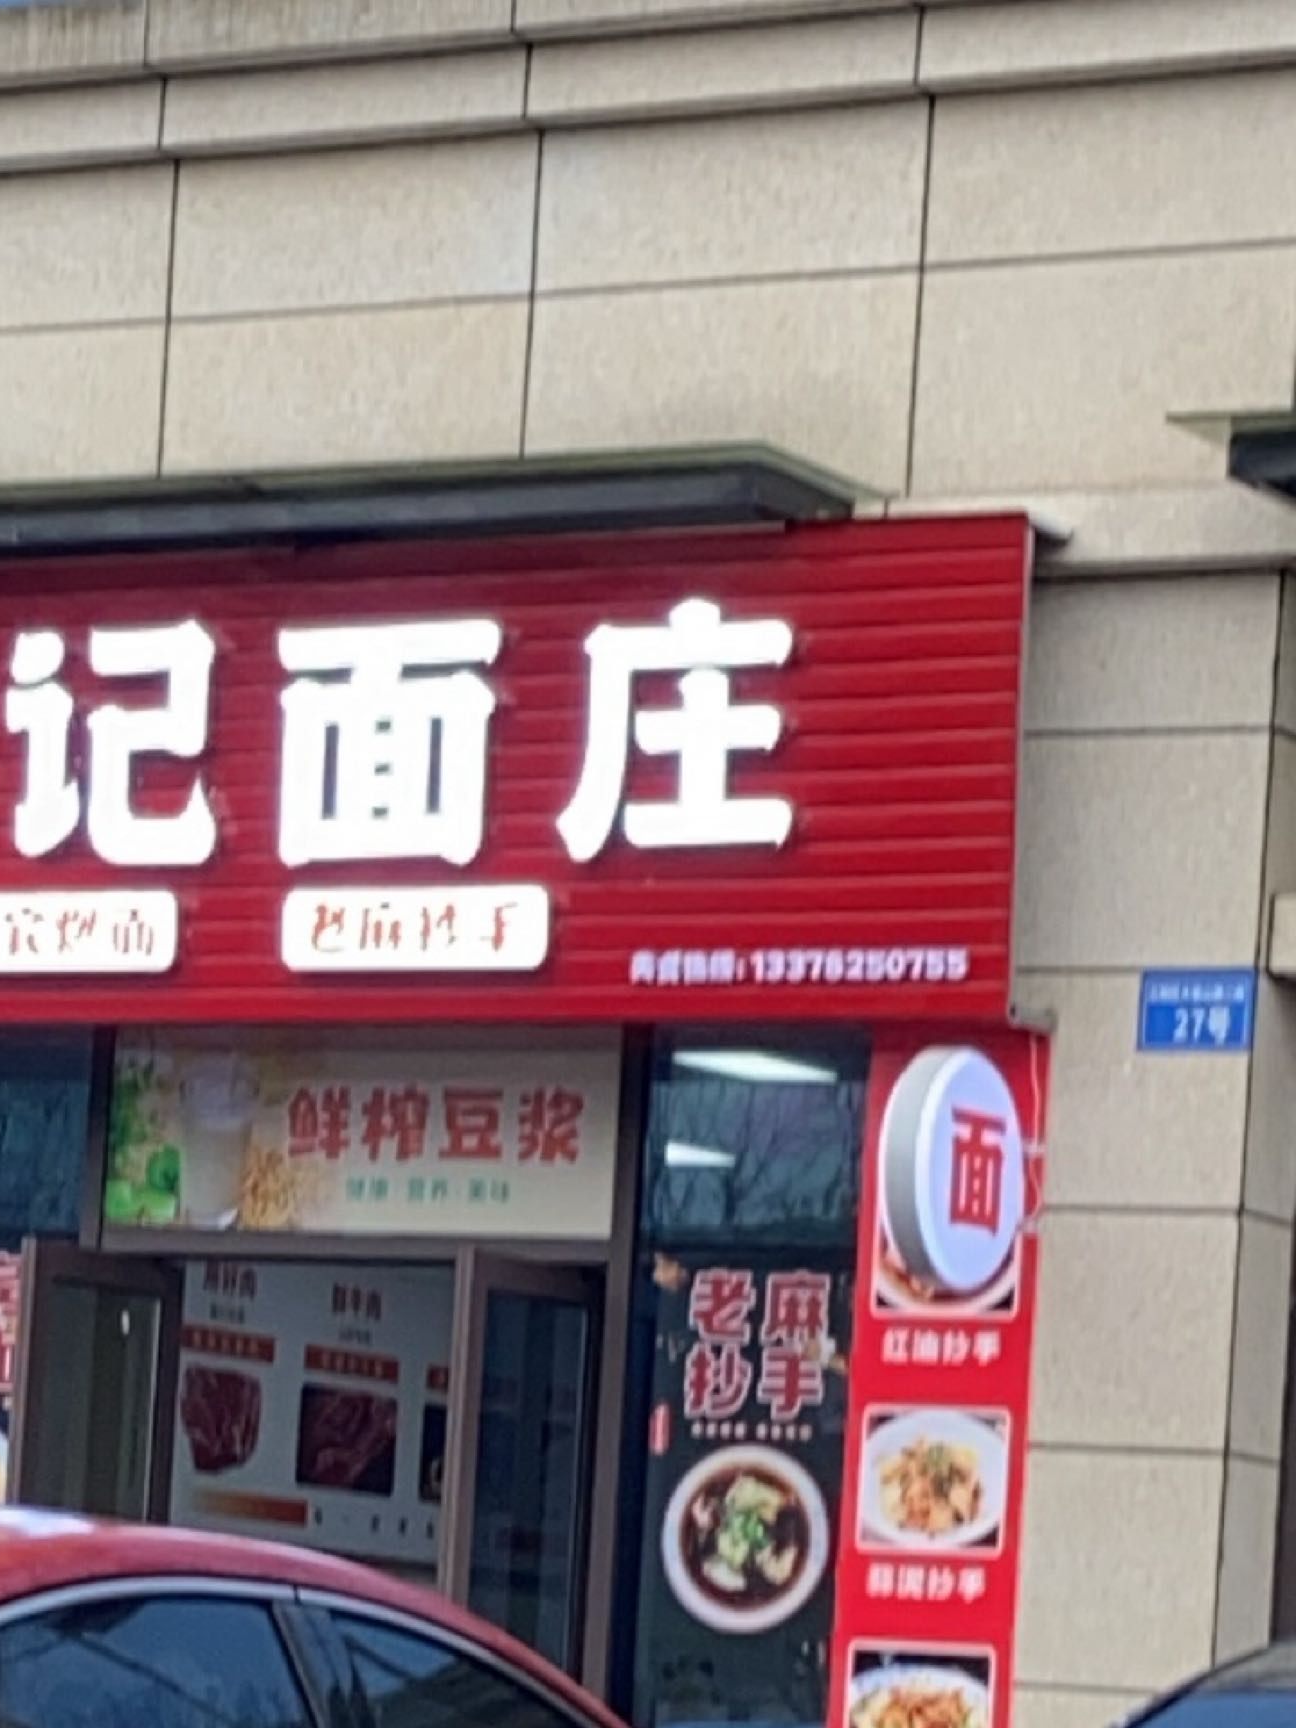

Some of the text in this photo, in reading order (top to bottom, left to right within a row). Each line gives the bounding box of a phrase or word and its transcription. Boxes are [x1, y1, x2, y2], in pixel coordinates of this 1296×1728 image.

[287, 1083, 586, 1164] 鲜榨豆浆
[949, 1105, 1008, 1238] 面
[690, 1269, 831, 1344] 老麻
[685, 1341, 823, 1421] 抄手
